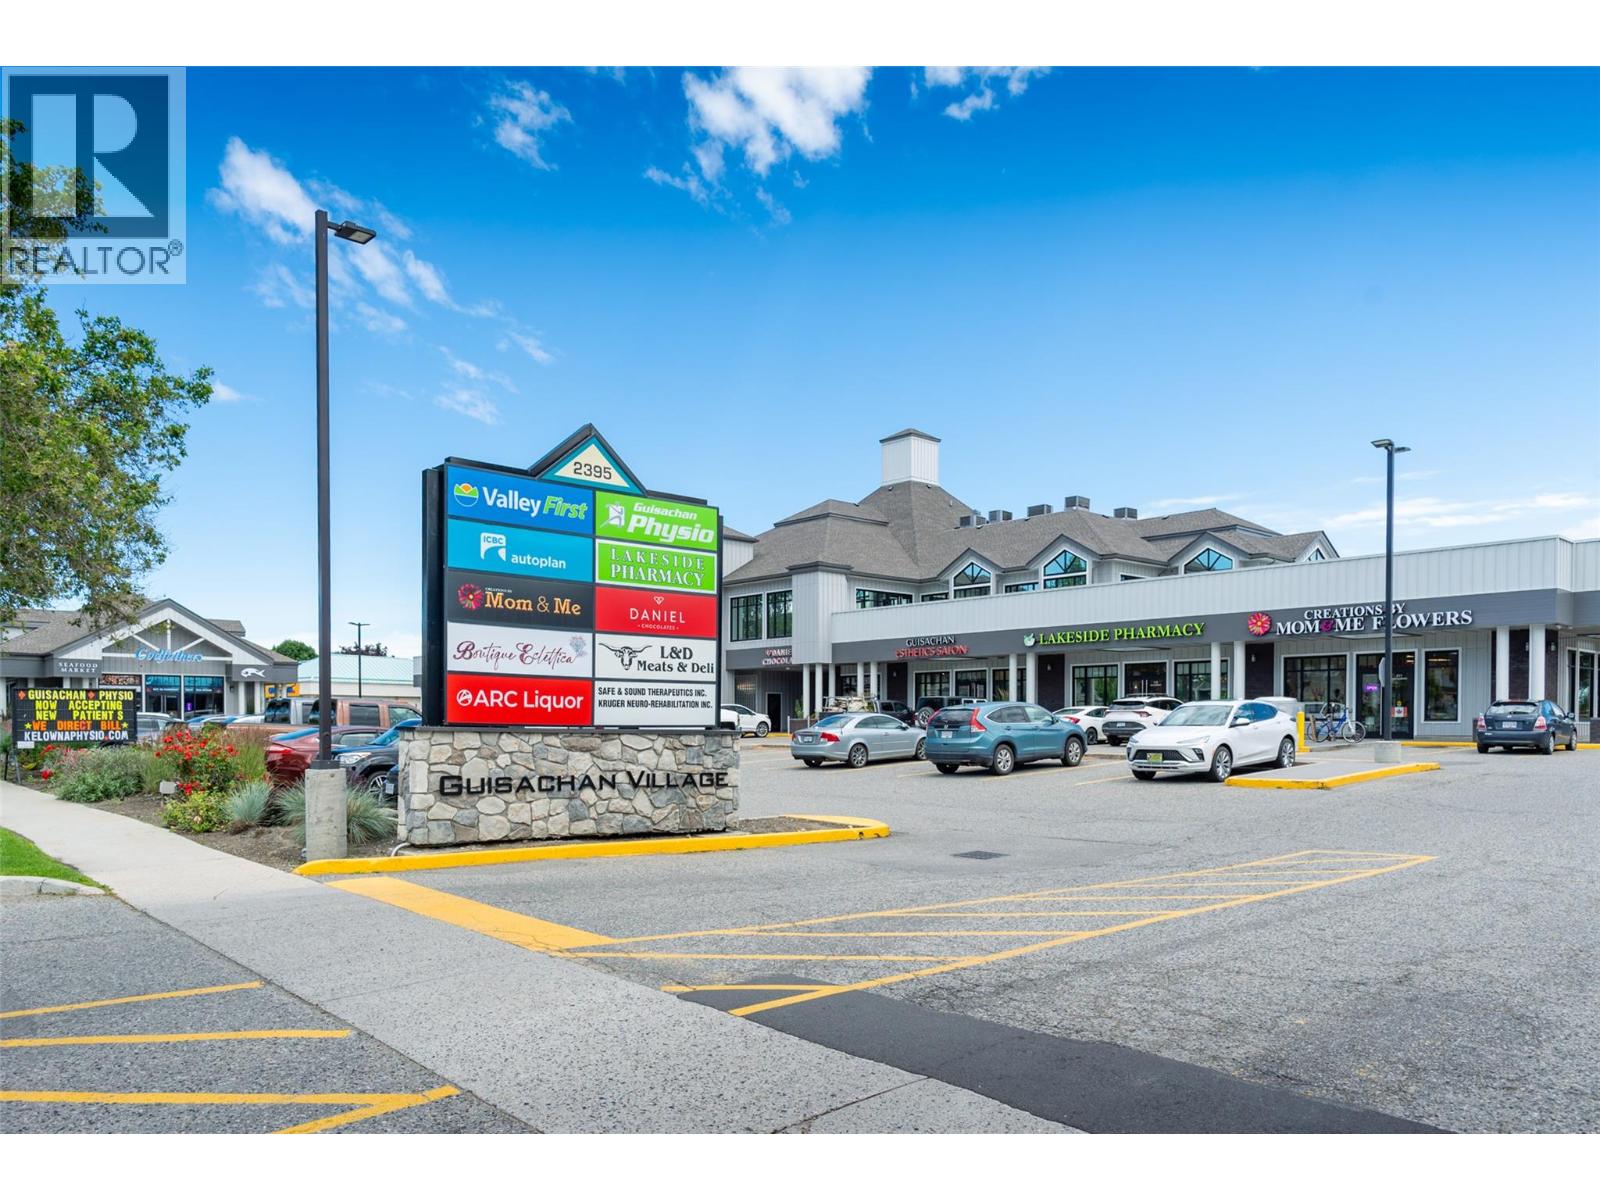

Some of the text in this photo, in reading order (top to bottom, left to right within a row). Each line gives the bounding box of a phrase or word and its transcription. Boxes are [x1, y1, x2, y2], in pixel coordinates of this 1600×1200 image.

[573, 461, 612, 480] 2395
[482, 486, 588, 520] Valley First
[633, 502, 697, 521] Guisachan
[626, 514, 715, 543] Physio
[483, 535, 504, 545] ICBC
[511, 553, 566, 569] autoplan
[611, 548, 705, 571] LAKESIDE
[610, 564, 705, 587] PHARMACY
[484, 591, 581, 615] Mom & Me
[629, 607, 685, 624] DANIEL
[1303, 604, 1383, 620] CREATIONS
[1372, 609, 1473, 631] FOWERS
[905, 635, 955, 647] GUISACHAN
[1039, 622, 1206, 645] LAKESIDE PHARMACY
[453, 640, 516, 671] Boutique
[660, 645, 693, 660] L&D
[770, 648, 793, 657] DANIE
[637, 660, 714, 674] Meats & Deli
[28, 689, 134, 700] GUISACHAN PHYSIO
[598, 686, 707, 697] SAFE & SOUND THERAPEUTICS INC.
[35, 700, 123, 710] NOW ACCEPTING
[473, 689, 584, 713] ARC Liquor
[598, 699, 713, 709] KRUGER NEURO-REHABILITATION INC.
[35, 710, 57, 720] NEW
[31, 720, 122, 731] WE DIRECT BILL
[24, 730, 129, 741] KELOWNAPHYSIO.COM
[439, 770, 729, 796] GUISACHAN VILLAGE
